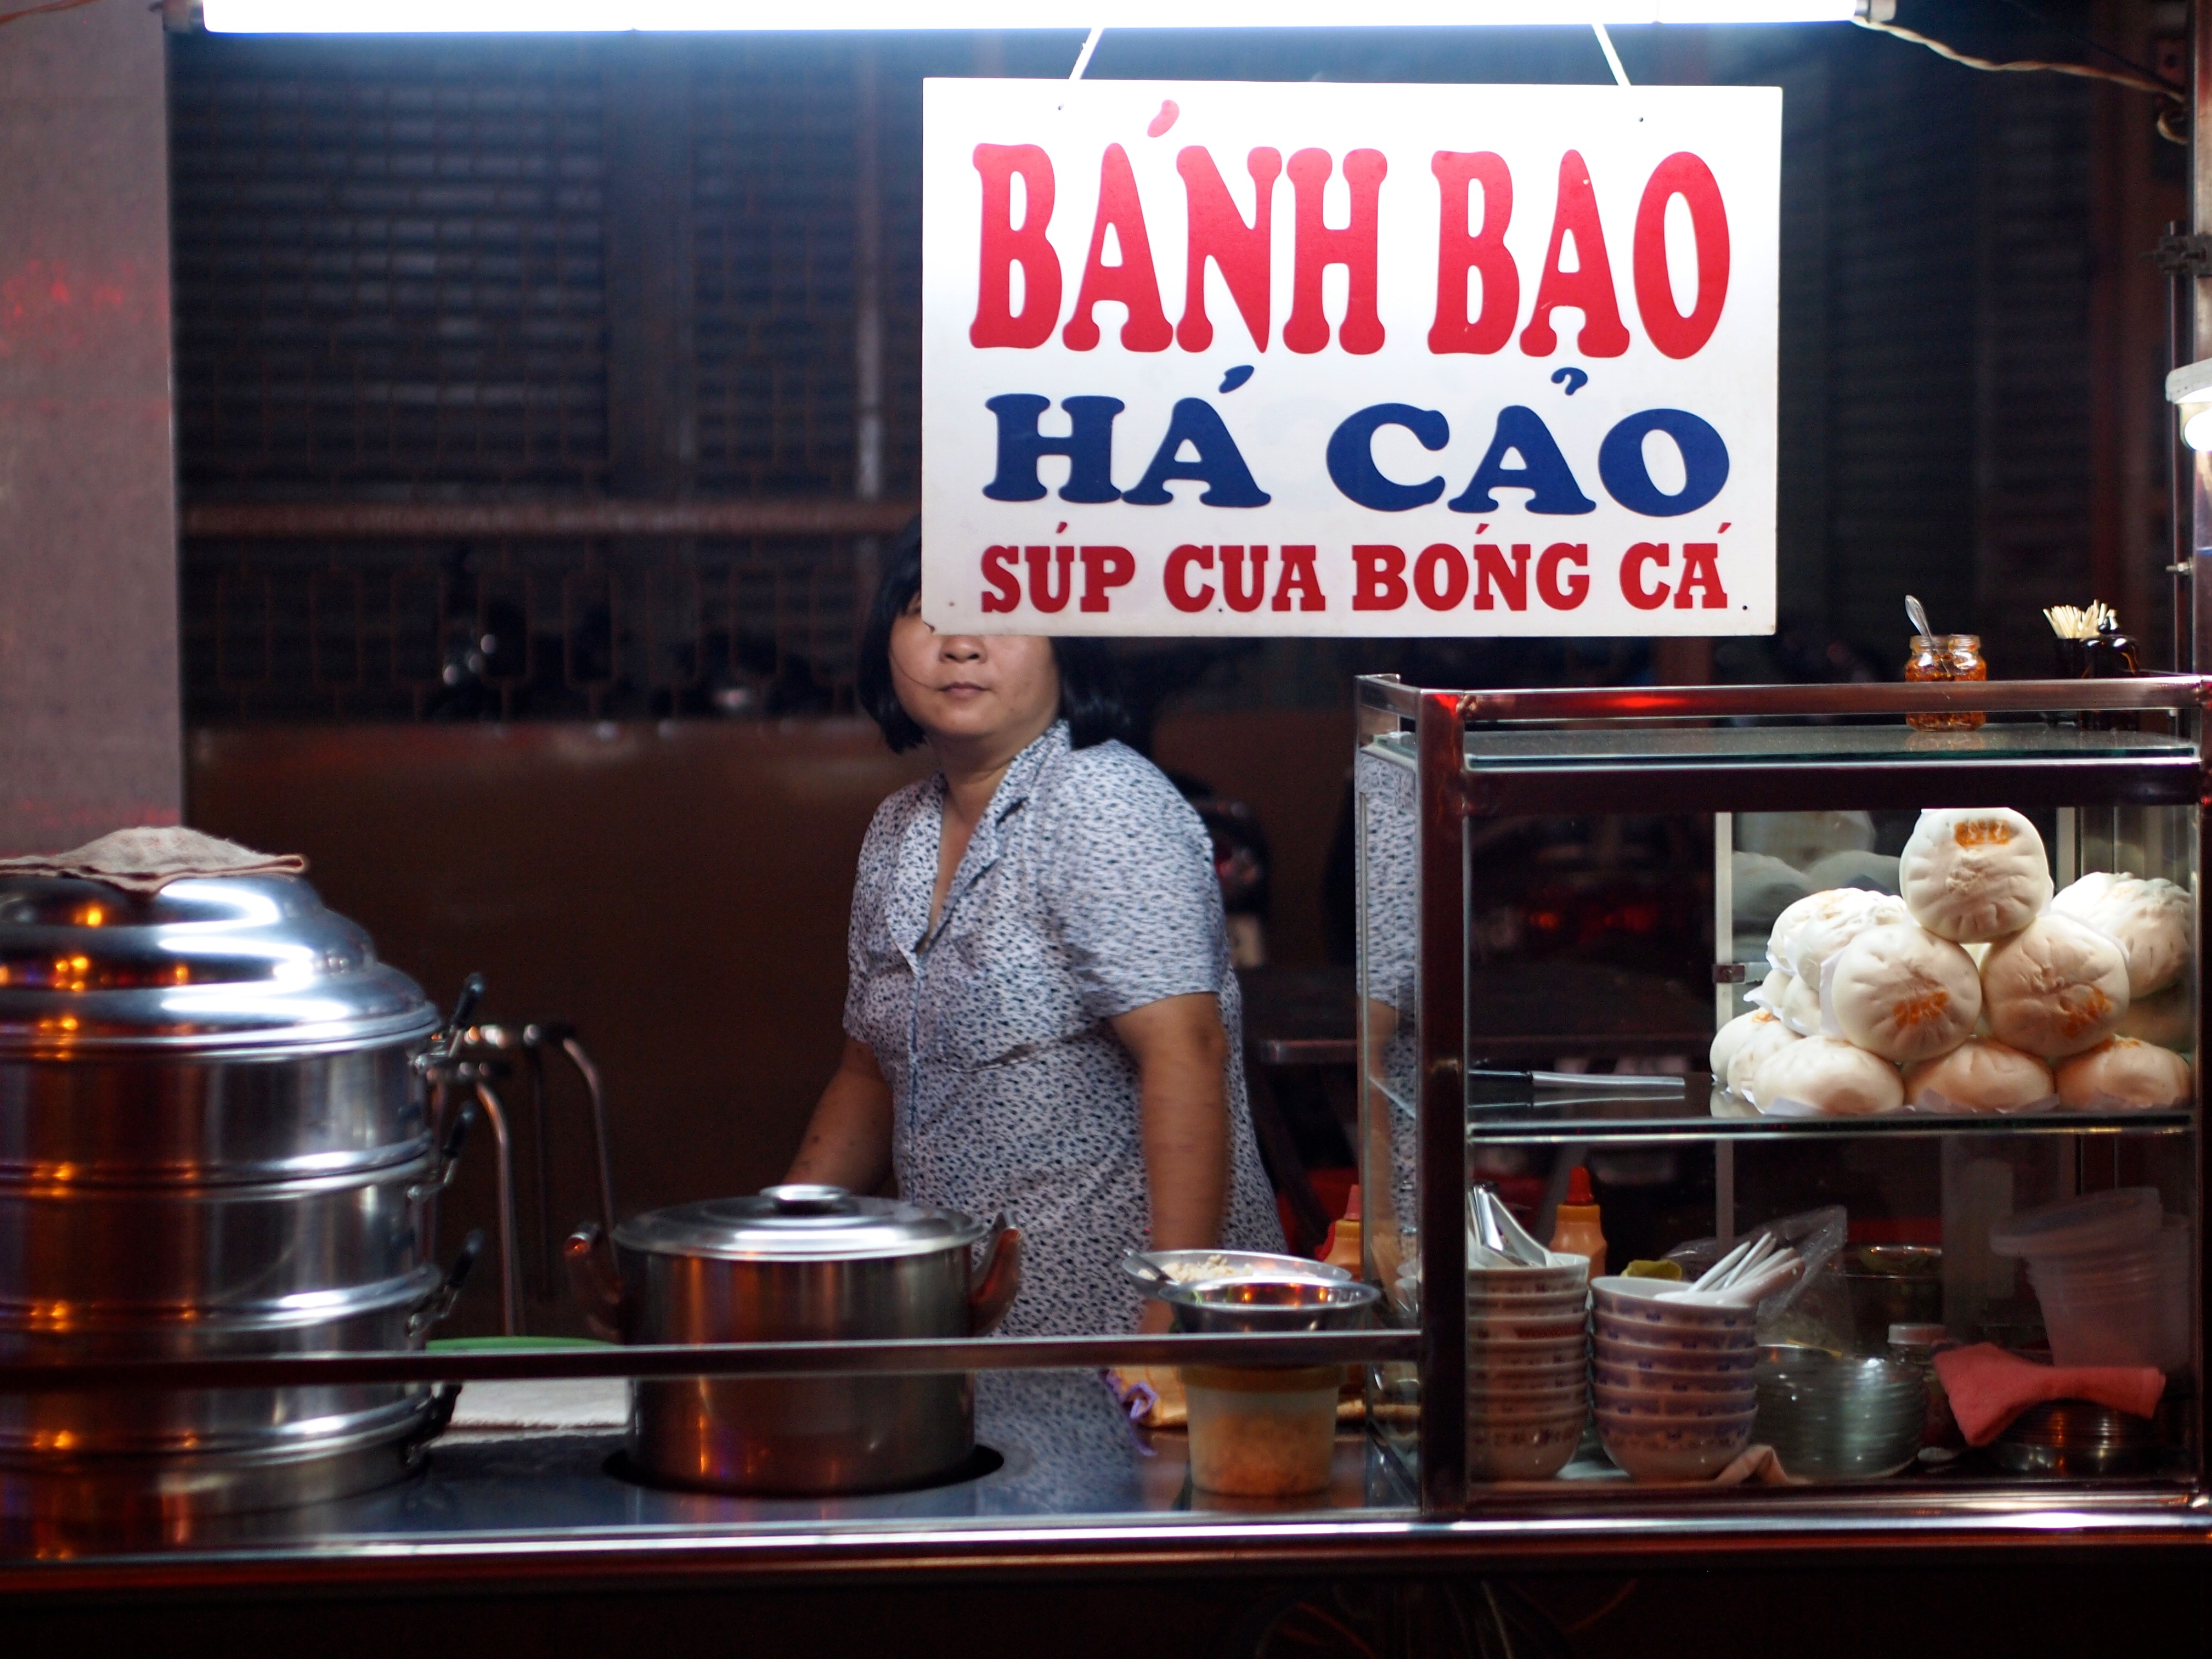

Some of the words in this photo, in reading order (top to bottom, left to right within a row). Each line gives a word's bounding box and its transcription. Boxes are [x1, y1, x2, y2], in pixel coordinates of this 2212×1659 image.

[969, 100, 1389, 356] BÁNH
[1427, 149, 1731, 360] BAO
[982, 364, 1272, 507] HÁ
[1328, 366, 1730, 516] CẢO
[981, 521, 1137, 614] SÚP
[1163, 544, 1327, 613] CUA
[1351, 522, 1592, 612] BÓNG
[1618, 521, 1731, 611] CÁ
